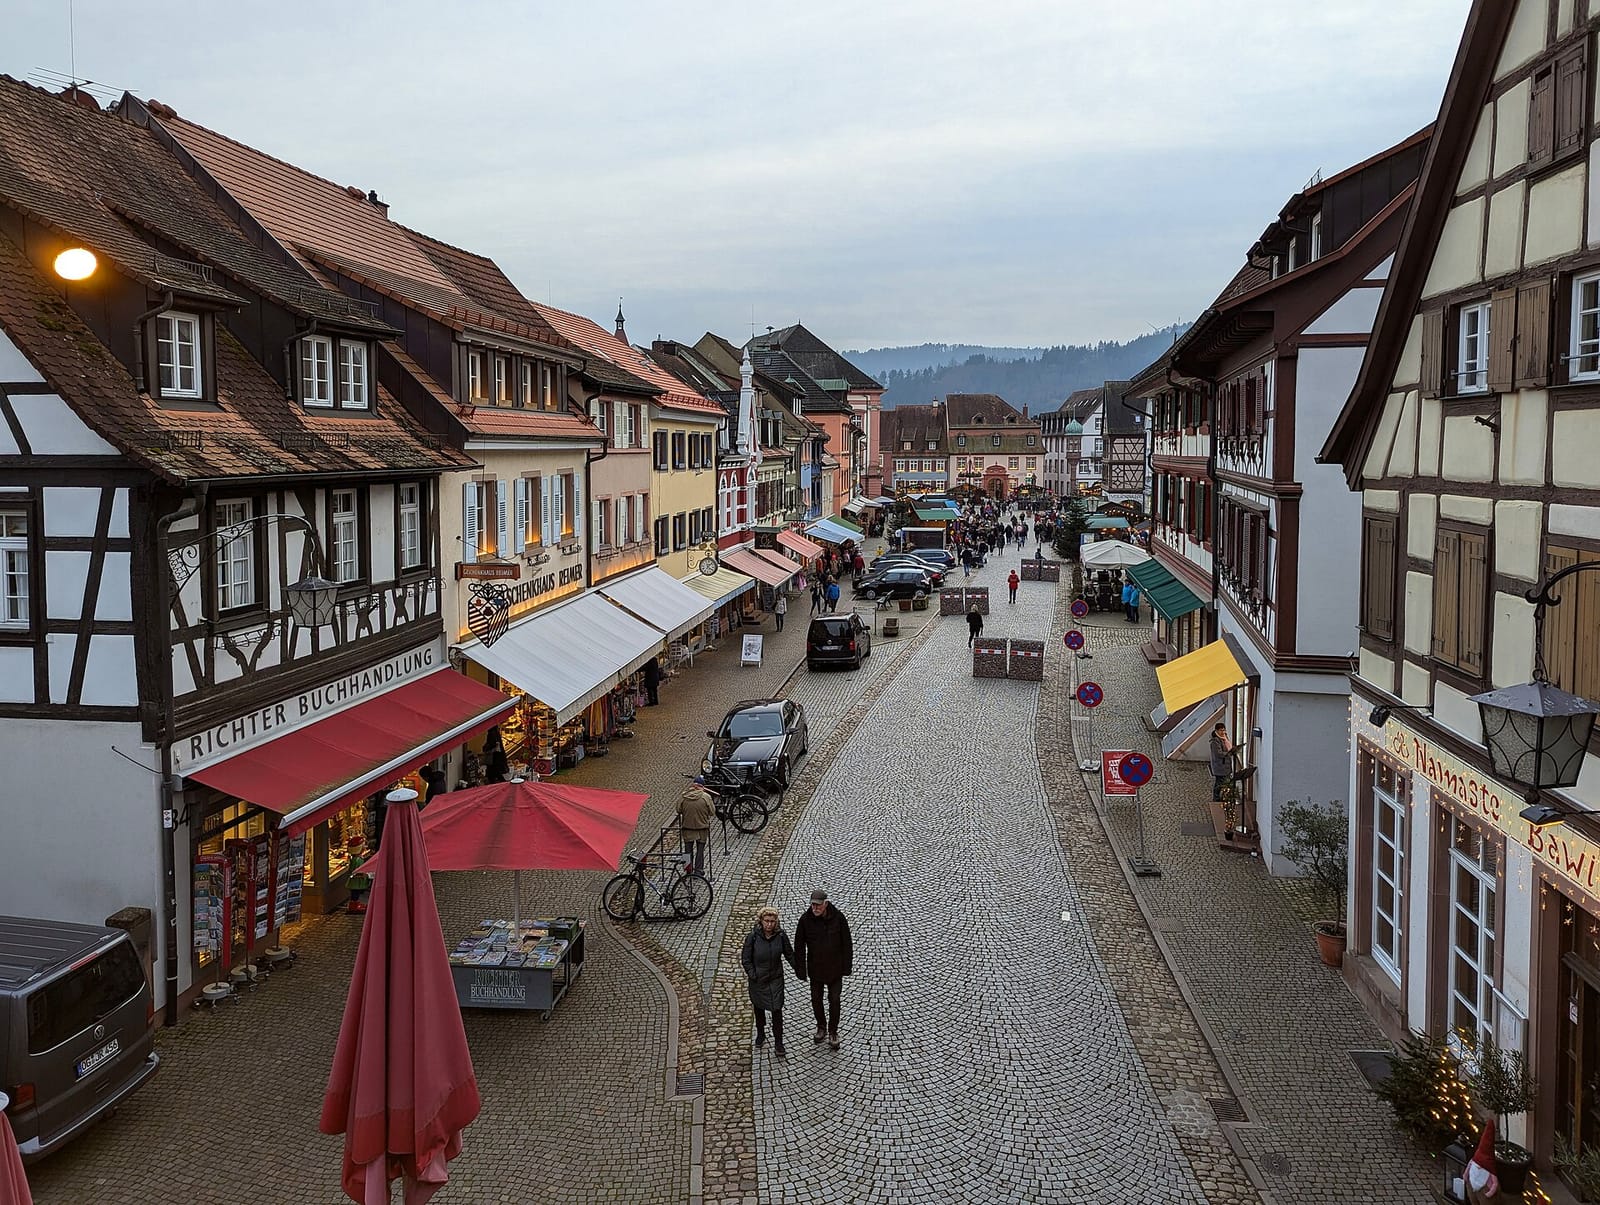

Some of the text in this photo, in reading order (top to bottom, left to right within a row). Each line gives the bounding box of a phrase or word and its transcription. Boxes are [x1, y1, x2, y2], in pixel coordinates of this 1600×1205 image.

[505, 564, 583, 607] SCHENKHAUS REIMER
[190, 648, 433, 760] RICHTER BUCHHANDLUNG
[470, 987, 526, 998] BUCHHANDLUNG
